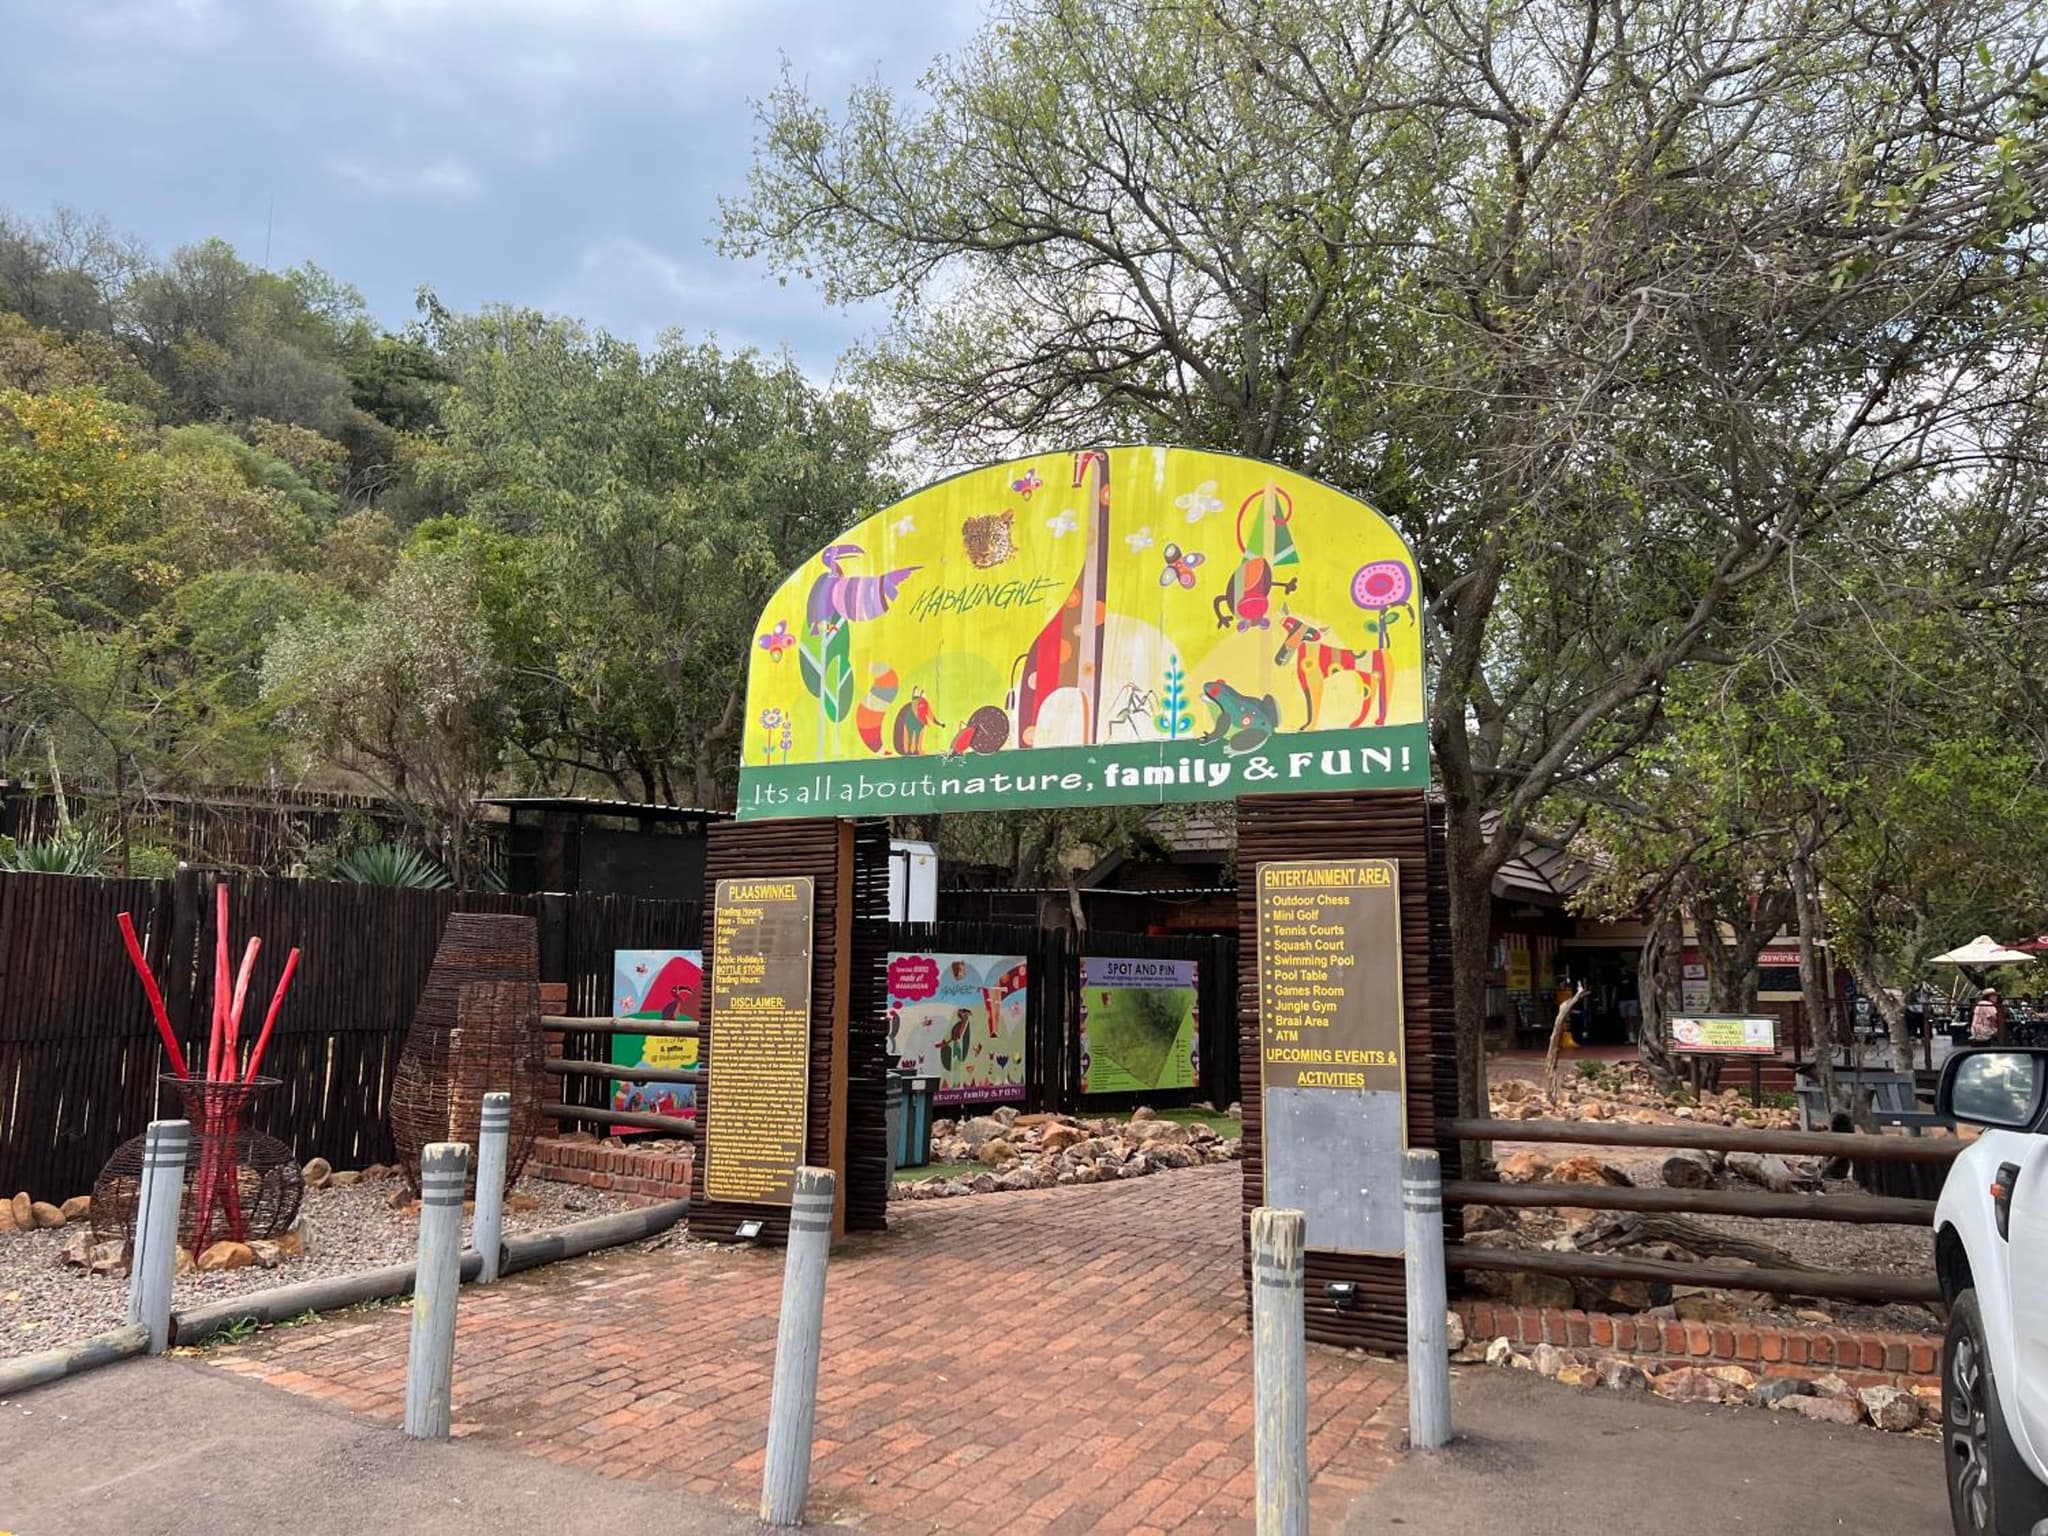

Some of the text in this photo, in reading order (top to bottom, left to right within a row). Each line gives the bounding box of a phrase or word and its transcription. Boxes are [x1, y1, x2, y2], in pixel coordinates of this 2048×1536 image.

[754, 746, 1411, 805] Its all about nature, family & FUN!
[1264, 867, 1391, 887] ENTERTAINMENT AREA
[729, 884, 798, 900] PLAASWINKEL
[1272, 893, 1351, 906] Outdoor Chess
[1272, 909, 1319, 921] Mini Golf
[1273, 924, 1345, 936] Tennis Courts
[1273, 939, 1345, 952] Squash Court
[1273, 954, 1355, 968] Swimming Pool
[1107, 963, 1133, 975] SPOT
[1135, 964, 1157, 976] AND
[1274, 969, 1328, 981] Pool Table
[1274, 984, 1345, 997] Games Room
[730, 997, 786, 1008] DISCLAIMER:
[1274, 1000, 1337, 1013] Jungle Gym
[1275, 1015, 1330, 1027] Braai Area
[1275, 1030, 1299, 1041] ATM
[1266, 1048, 1397, 1064] UPCOMING EVENTS &
[1298, 1071, 1365, 1086] ACTIVITIES
